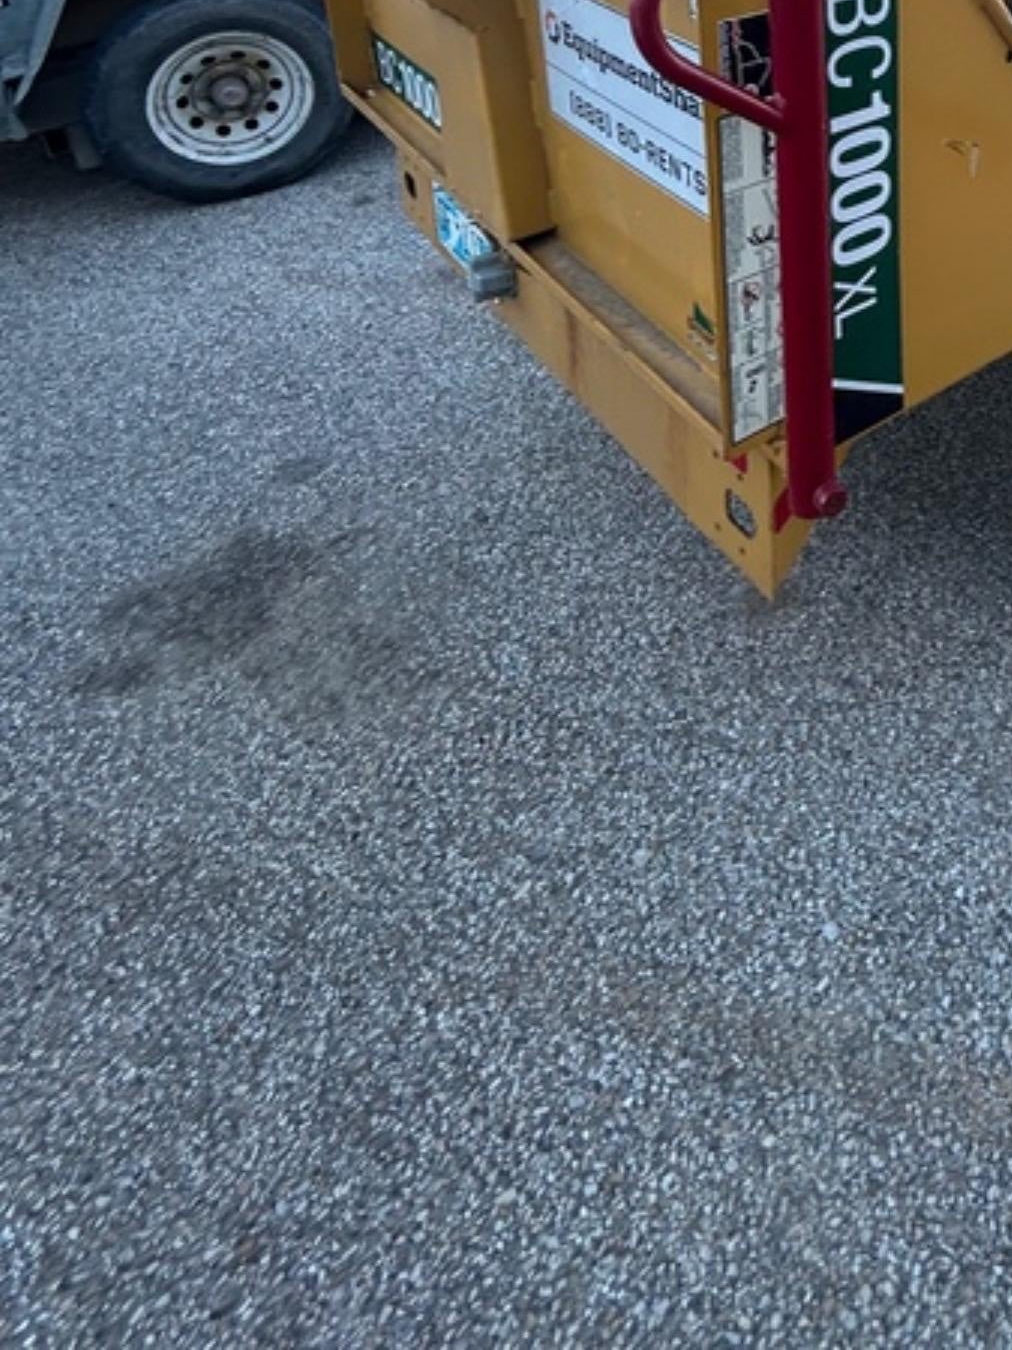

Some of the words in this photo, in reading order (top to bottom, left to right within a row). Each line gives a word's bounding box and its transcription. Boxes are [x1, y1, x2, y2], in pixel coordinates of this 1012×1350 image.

[563, 21, 702, 119] EquipmentSha
[569, 89, 613, 139] (888)
[616, 121, 706, 196] 80-RENTS
[833, 265, 877, 340] XL
